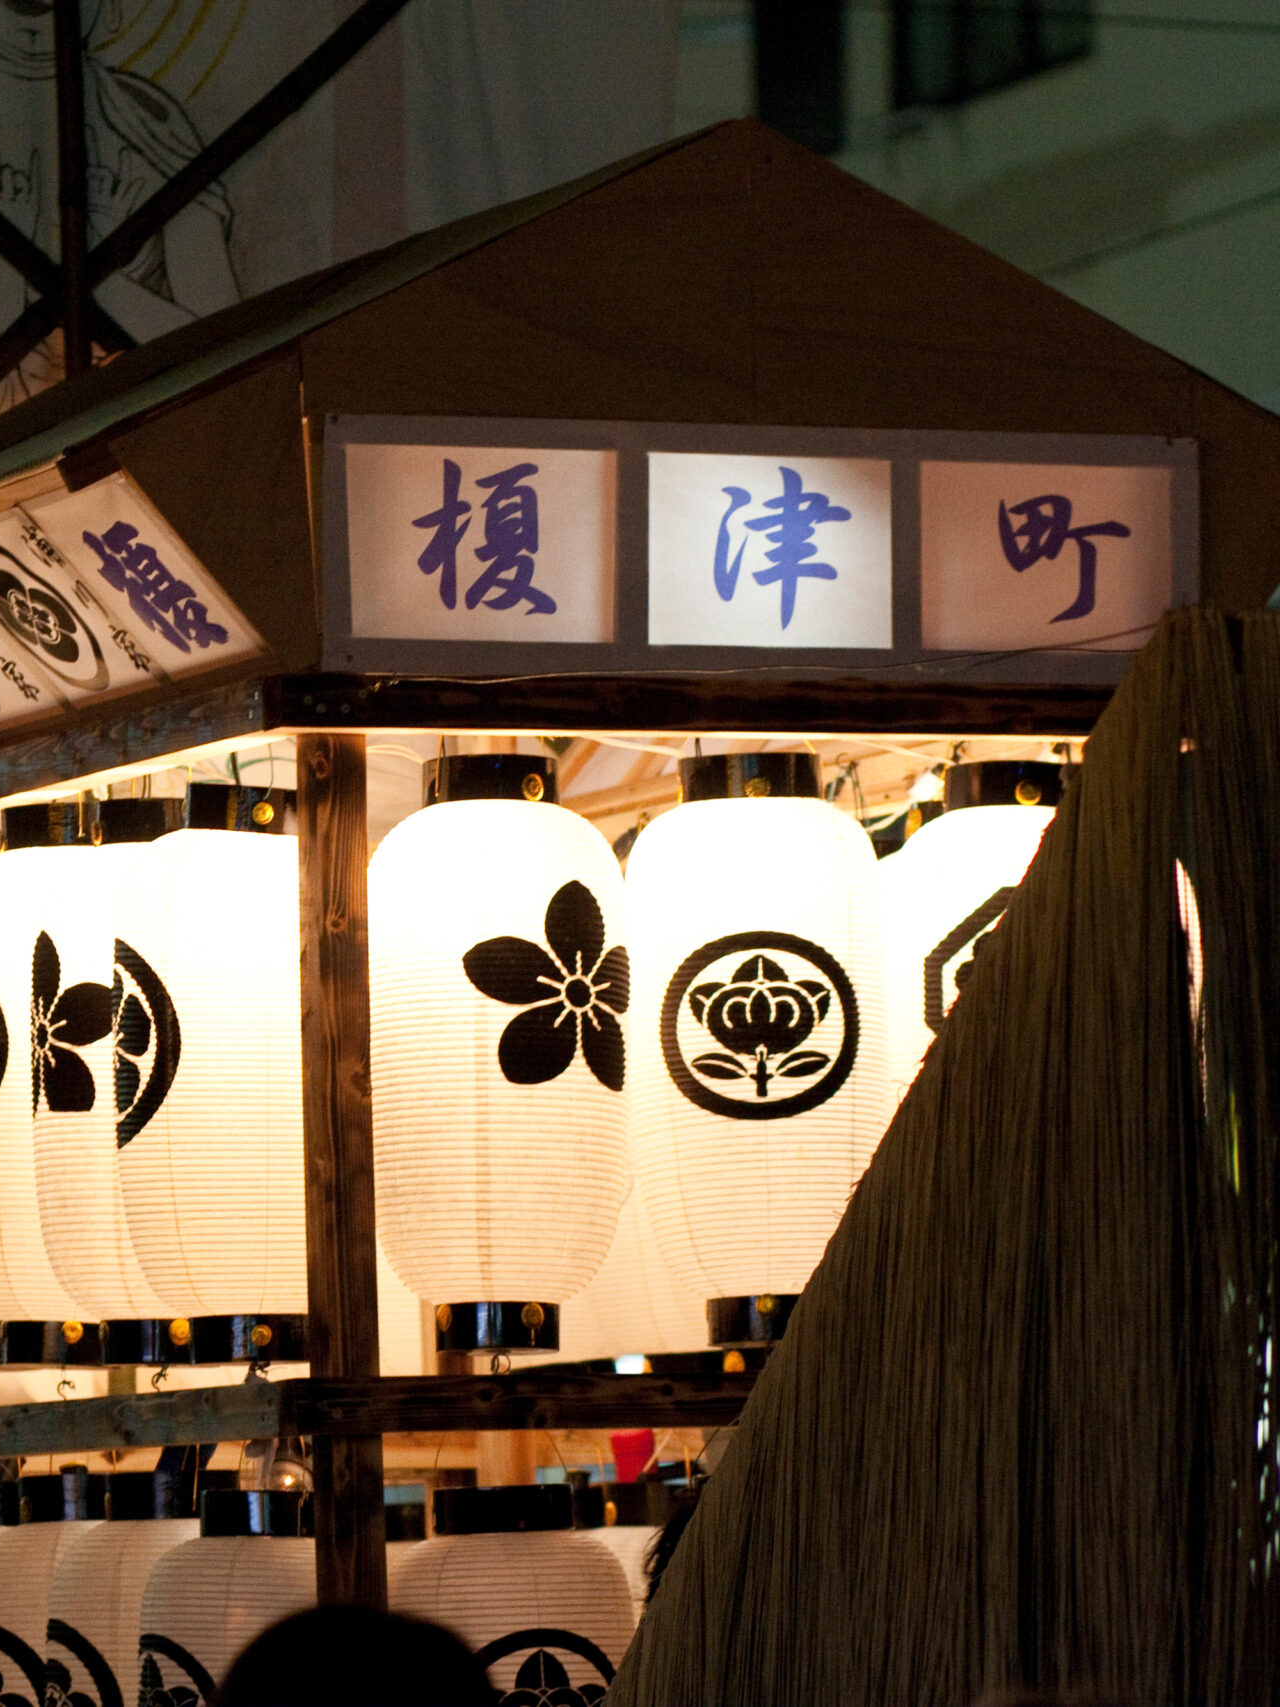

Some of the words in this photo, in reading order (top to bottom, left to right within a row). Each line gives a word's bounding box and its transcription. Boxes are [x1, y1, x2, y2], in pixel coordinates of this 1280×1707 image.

[82, 520, 230, 655] 榎
[411, 458, 1132, 632] 榎津町
